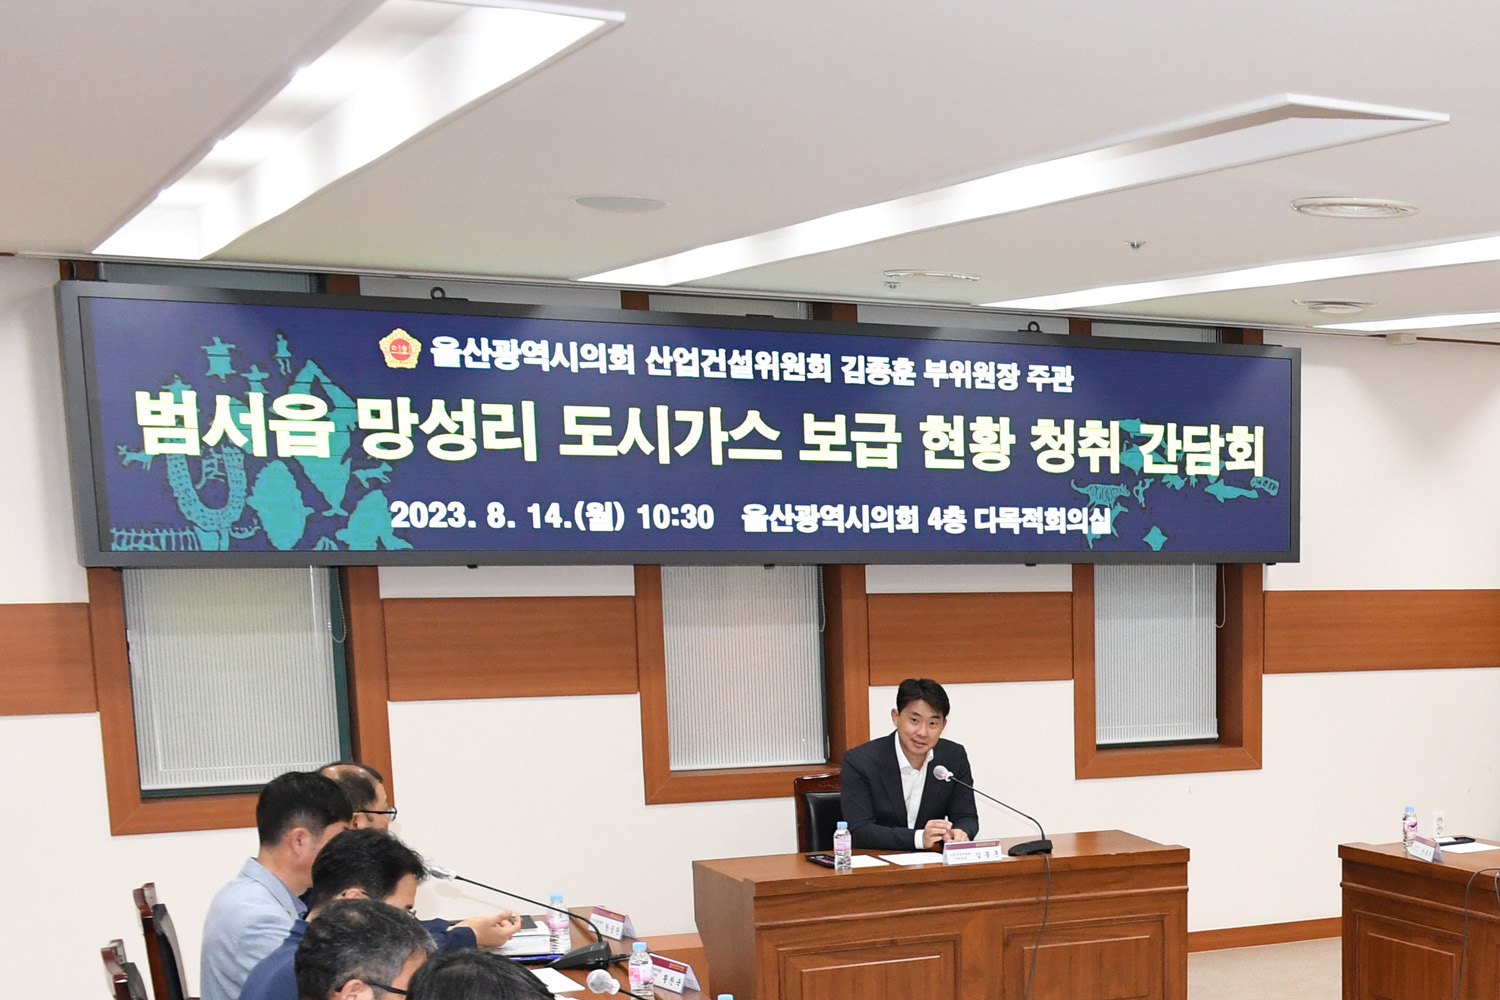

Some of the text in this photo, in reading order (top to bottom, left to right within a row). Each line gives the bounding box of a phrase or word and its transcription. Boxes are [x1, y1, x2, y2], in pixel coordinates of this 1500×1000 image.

[430, 336, 1075, 393] 울산광역시의회 산업건설위원회 김종훈 부위원장 주관
[135, 389, 1265, 478] 범서읍 망성리 도시가스 보급 현황 청취 간담회
[389, 500, 1112, 535] 2023. 8. 14.(월) 10:30 울산광역시의회 4층 다목적회의실
